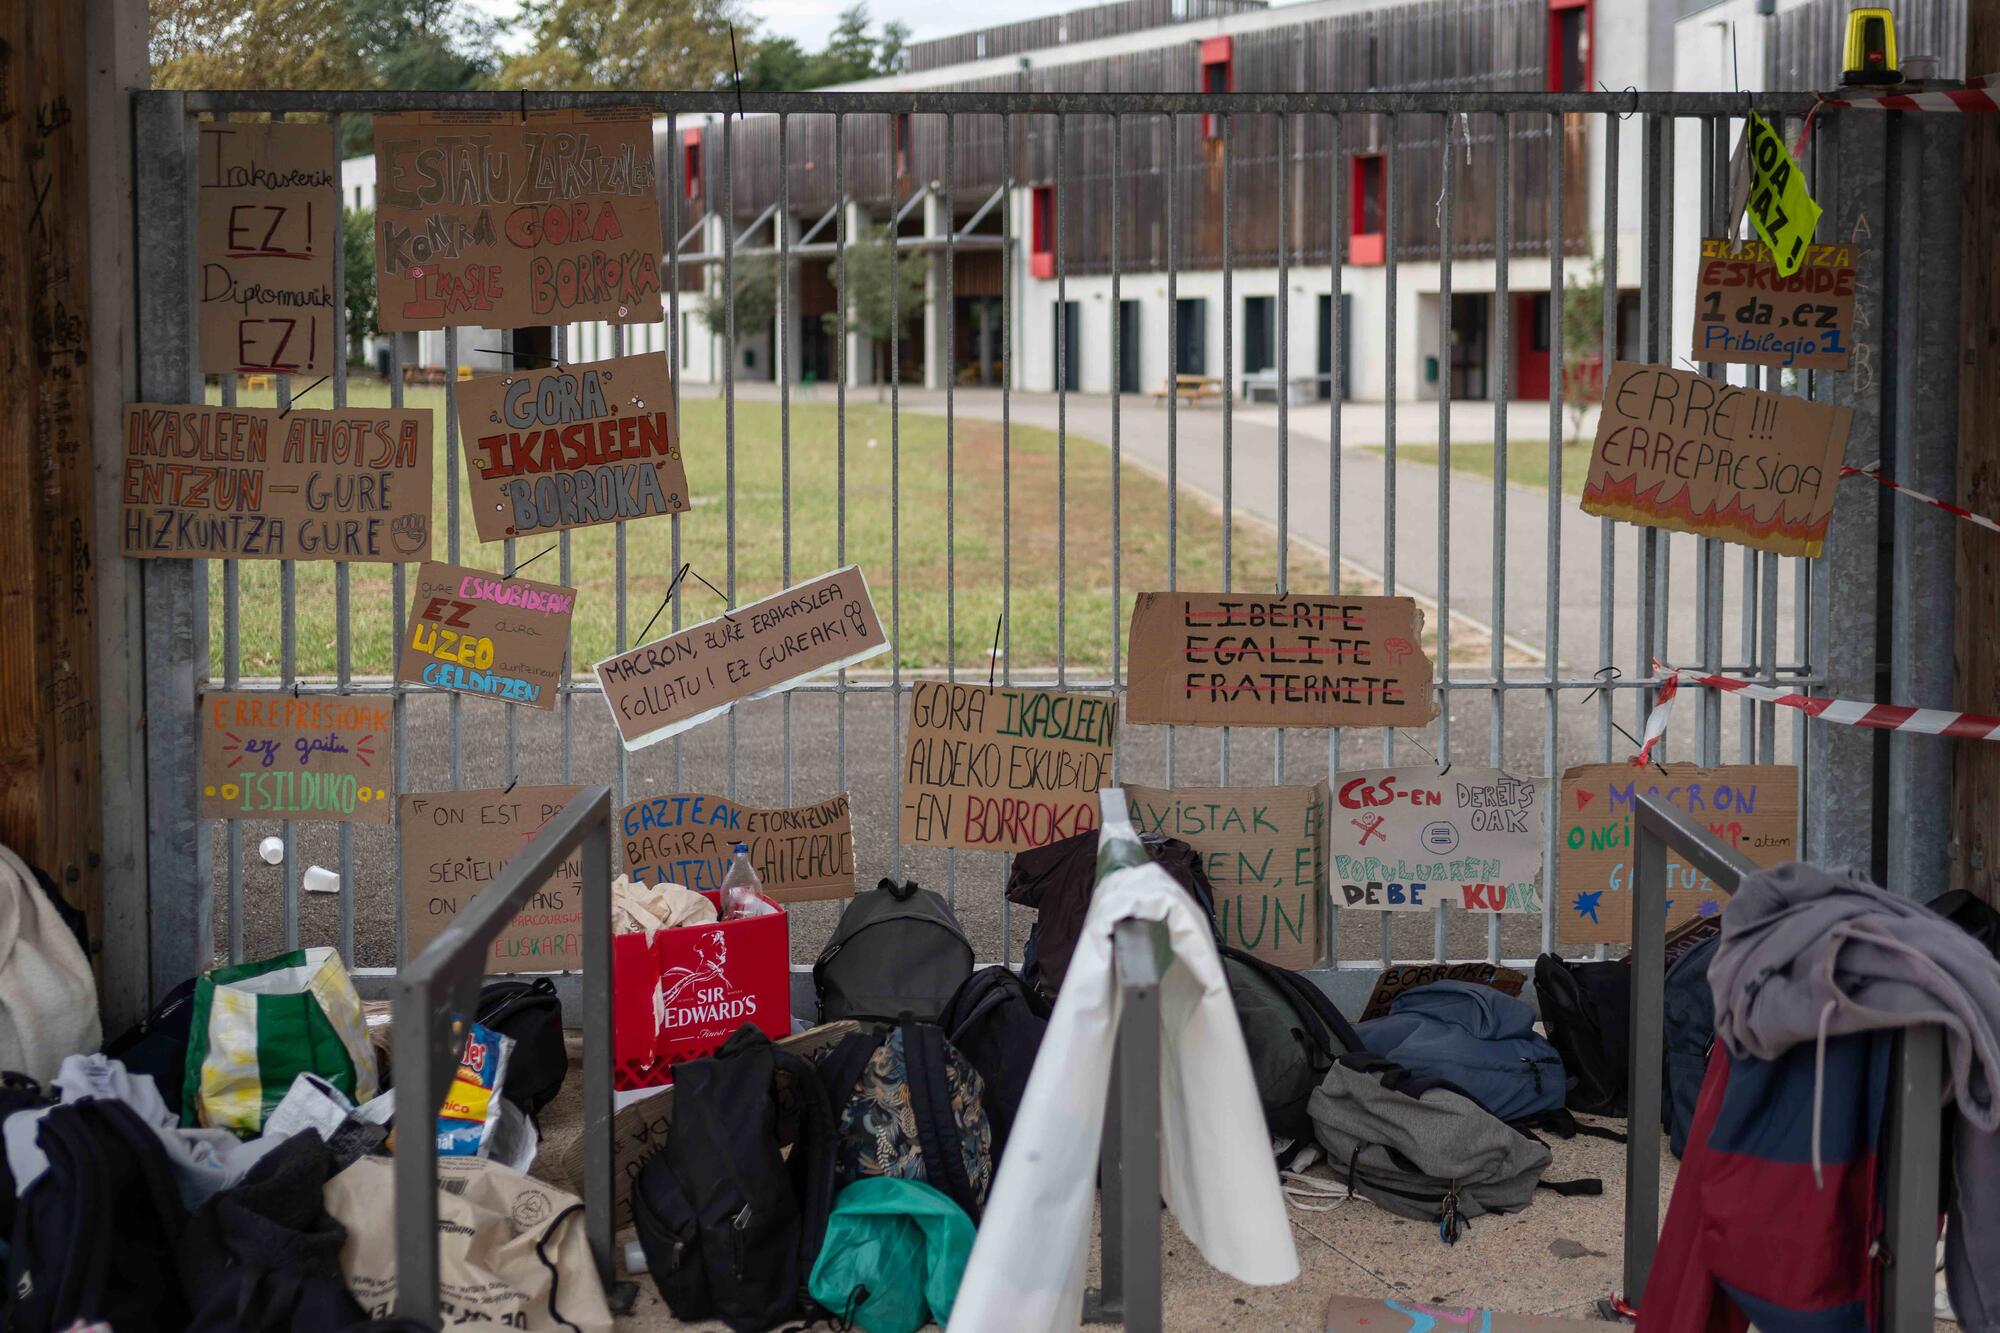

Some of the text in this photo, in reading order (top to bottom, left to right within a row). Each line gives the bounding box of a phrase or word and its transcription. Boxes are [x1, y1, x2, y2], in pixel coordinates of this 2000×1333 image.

[383, 133, 511, 210] ESTATU
[383, 202, 623, 276] KONTRA GORA
[402, 250, 660, 320] IKASLE BORROKA
[1705, 325, 1846, 366] Pribilegio 1
[503, 369, 609, 430] GORA
[129, 409, 268, 463] IKASLEEN
[283, 417, 418, 470] AHOTSA
[477, 411, 670, 481] IKASLEEN
[122, 458, 264, 512] ENTZUN
[306, 471, 394, 513] GURE
[510, 462, 668, 531] BORROKA
[299, 518, 384, 556] GURE
[421, 597, 477, 629] EZ
[751, 583, 844, 635] ERAKASLEA
[726, 658, 751, 684] EZ
[1185, 636, 1371, 666] EGALITE
[1186, 673, 1406, 705] FRATERNITE
[913, 683, 1118, 748] GORA IKASLEEN
[909, 738, 1001, 788] ALDEKO
[239, 770, 358, 815] ISILDUKO
[1456, 777, 1535, 809] DERETS
[481, 804, 521, 825] EST
[624, 797, 742, 837] GAZTEAK
[965, 795, 1095, 847] BORROKA
[1471, 808, 1529, 833] OAK
[428, 898, 456, 915] ON
[1341, 881, 1543, 913] DEBE KUAK
[664, 994, 757, 1030] EDWARD'S
[697, 986, 725, 1005] SIR
